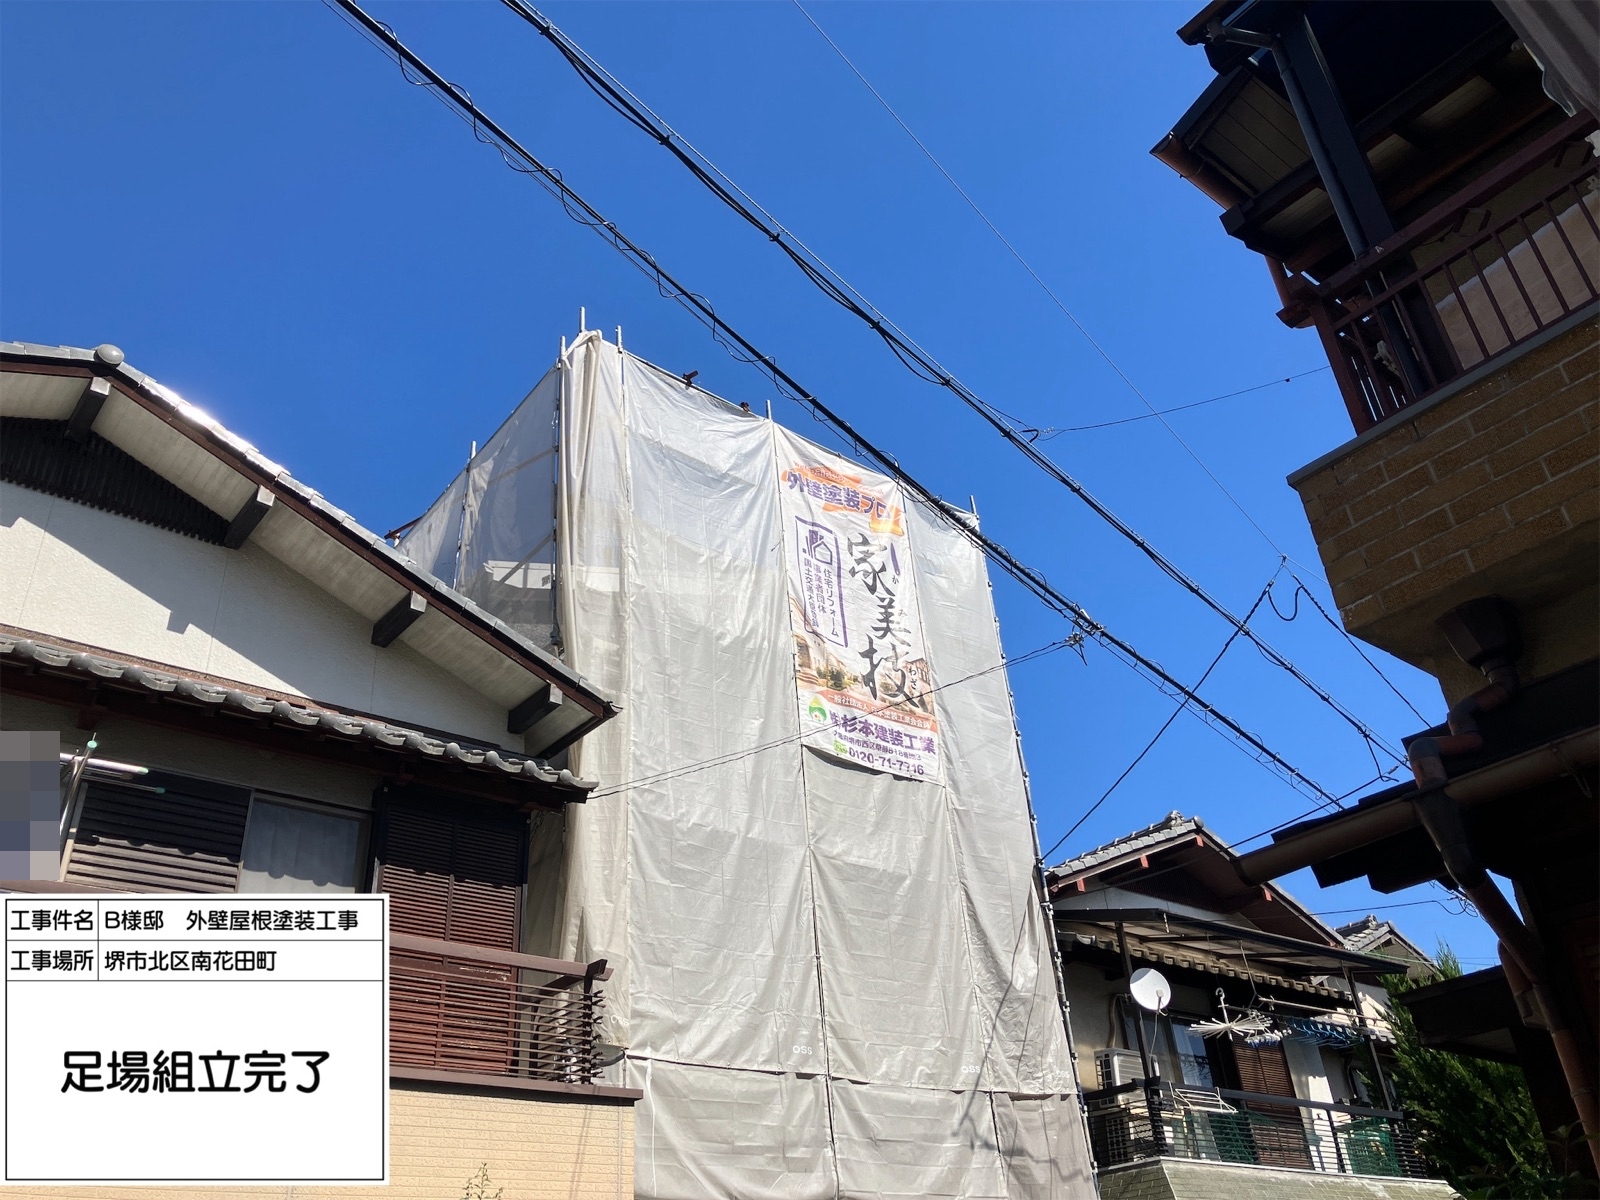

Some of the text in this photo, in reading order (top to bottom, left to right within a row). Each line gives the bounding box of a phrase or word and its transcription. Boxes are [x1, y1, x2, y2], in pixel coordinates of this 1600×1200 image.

[787, 470, 892, 519] 外壁塗装プロ
[824, 568, 839, 637] 住宅リフォーム
[792, 1045, 813, 1055] OSS
